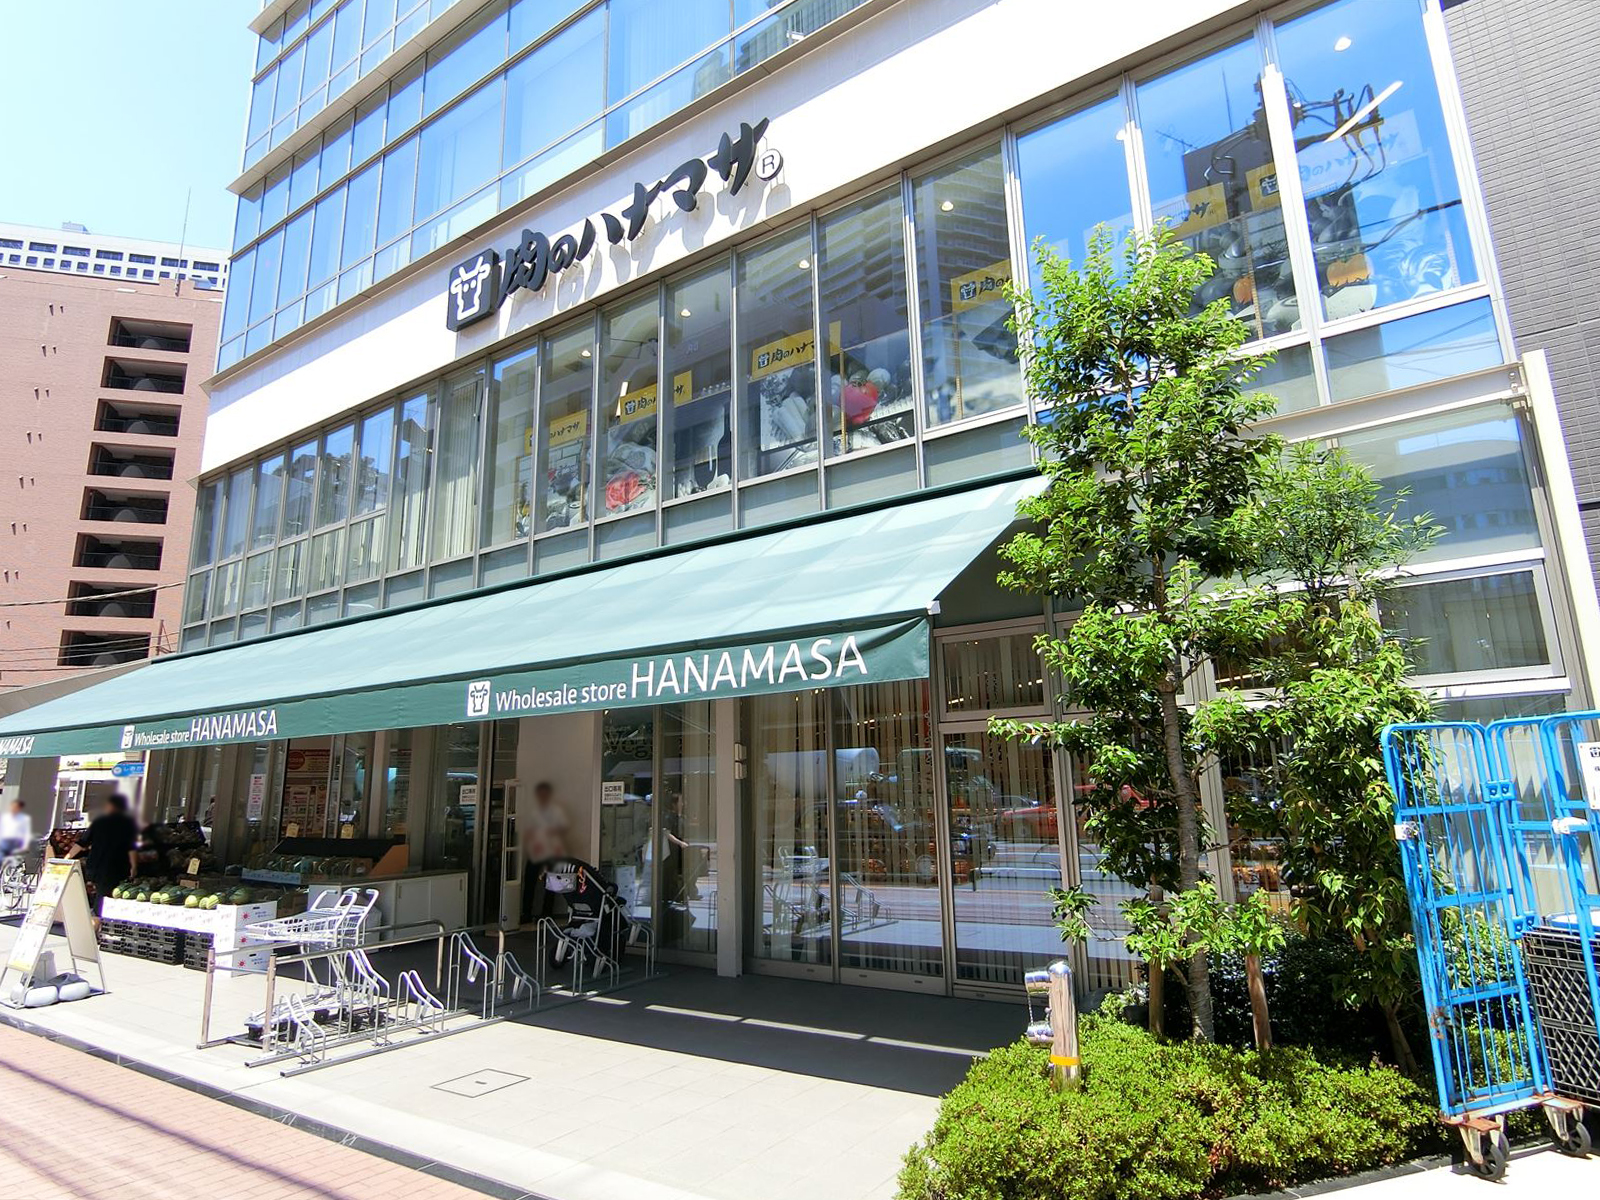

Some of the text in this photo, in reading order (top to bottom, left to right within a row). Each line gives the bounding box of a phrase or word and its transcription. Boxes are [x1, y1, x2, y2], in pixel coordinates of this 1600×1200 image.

[499, 117, 770, 308] 肉のハナマサ
[496, 635, 868, 712] Wholesale store HANAMASA
[134, 709, 278, 747] Wholesale store HANAMASA
